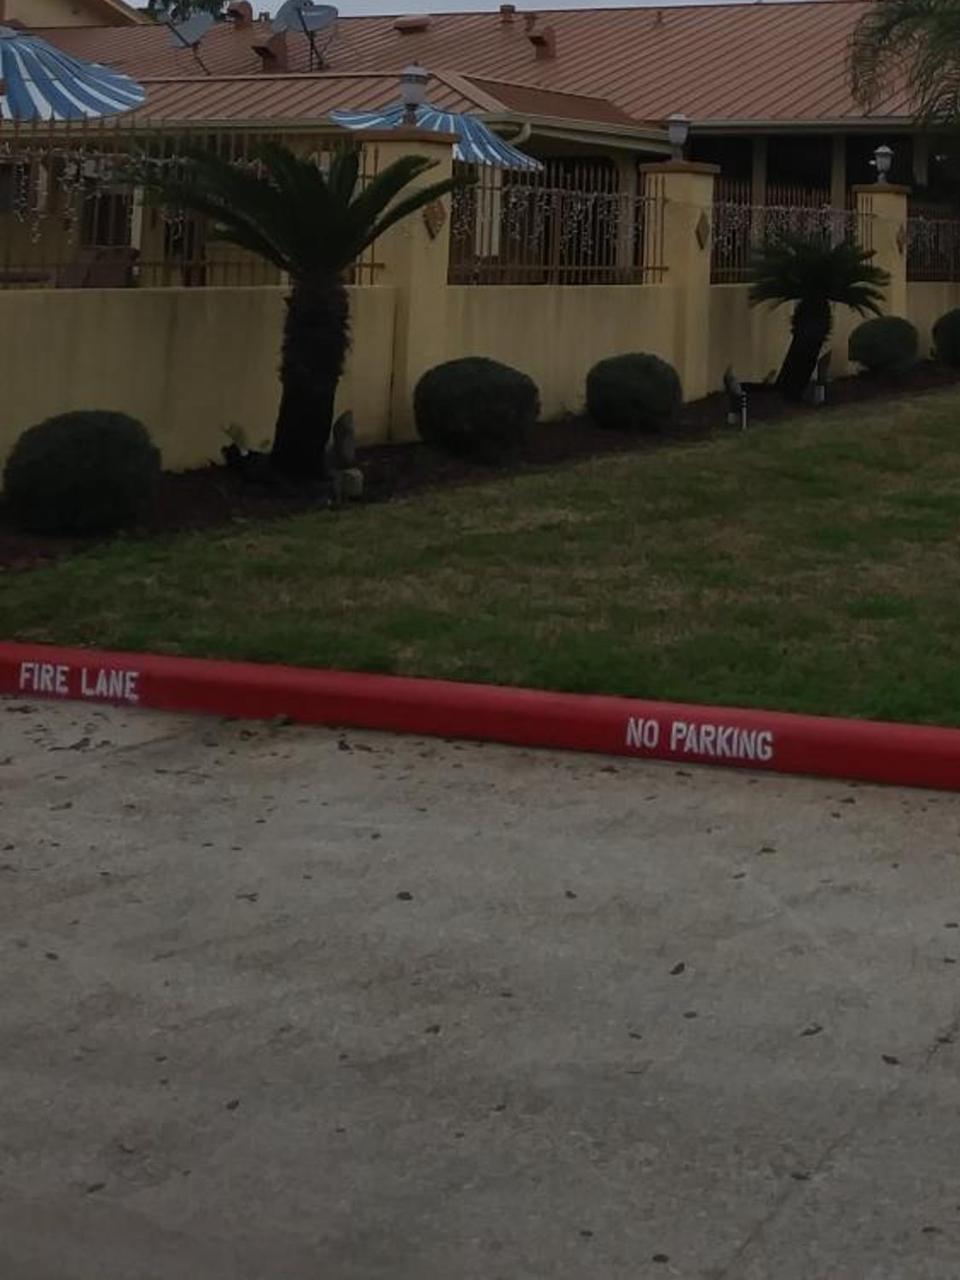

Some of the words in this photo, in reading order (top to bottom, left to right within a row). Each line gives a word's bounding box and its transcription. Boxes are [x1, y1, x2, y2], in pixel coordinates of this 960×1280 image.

[19, 661, 70, 694] FIRE
[81, 667, 140, 701] LANE
[626, 716, 660, 749] NO
[670, 720, 774, 761] PARKING
